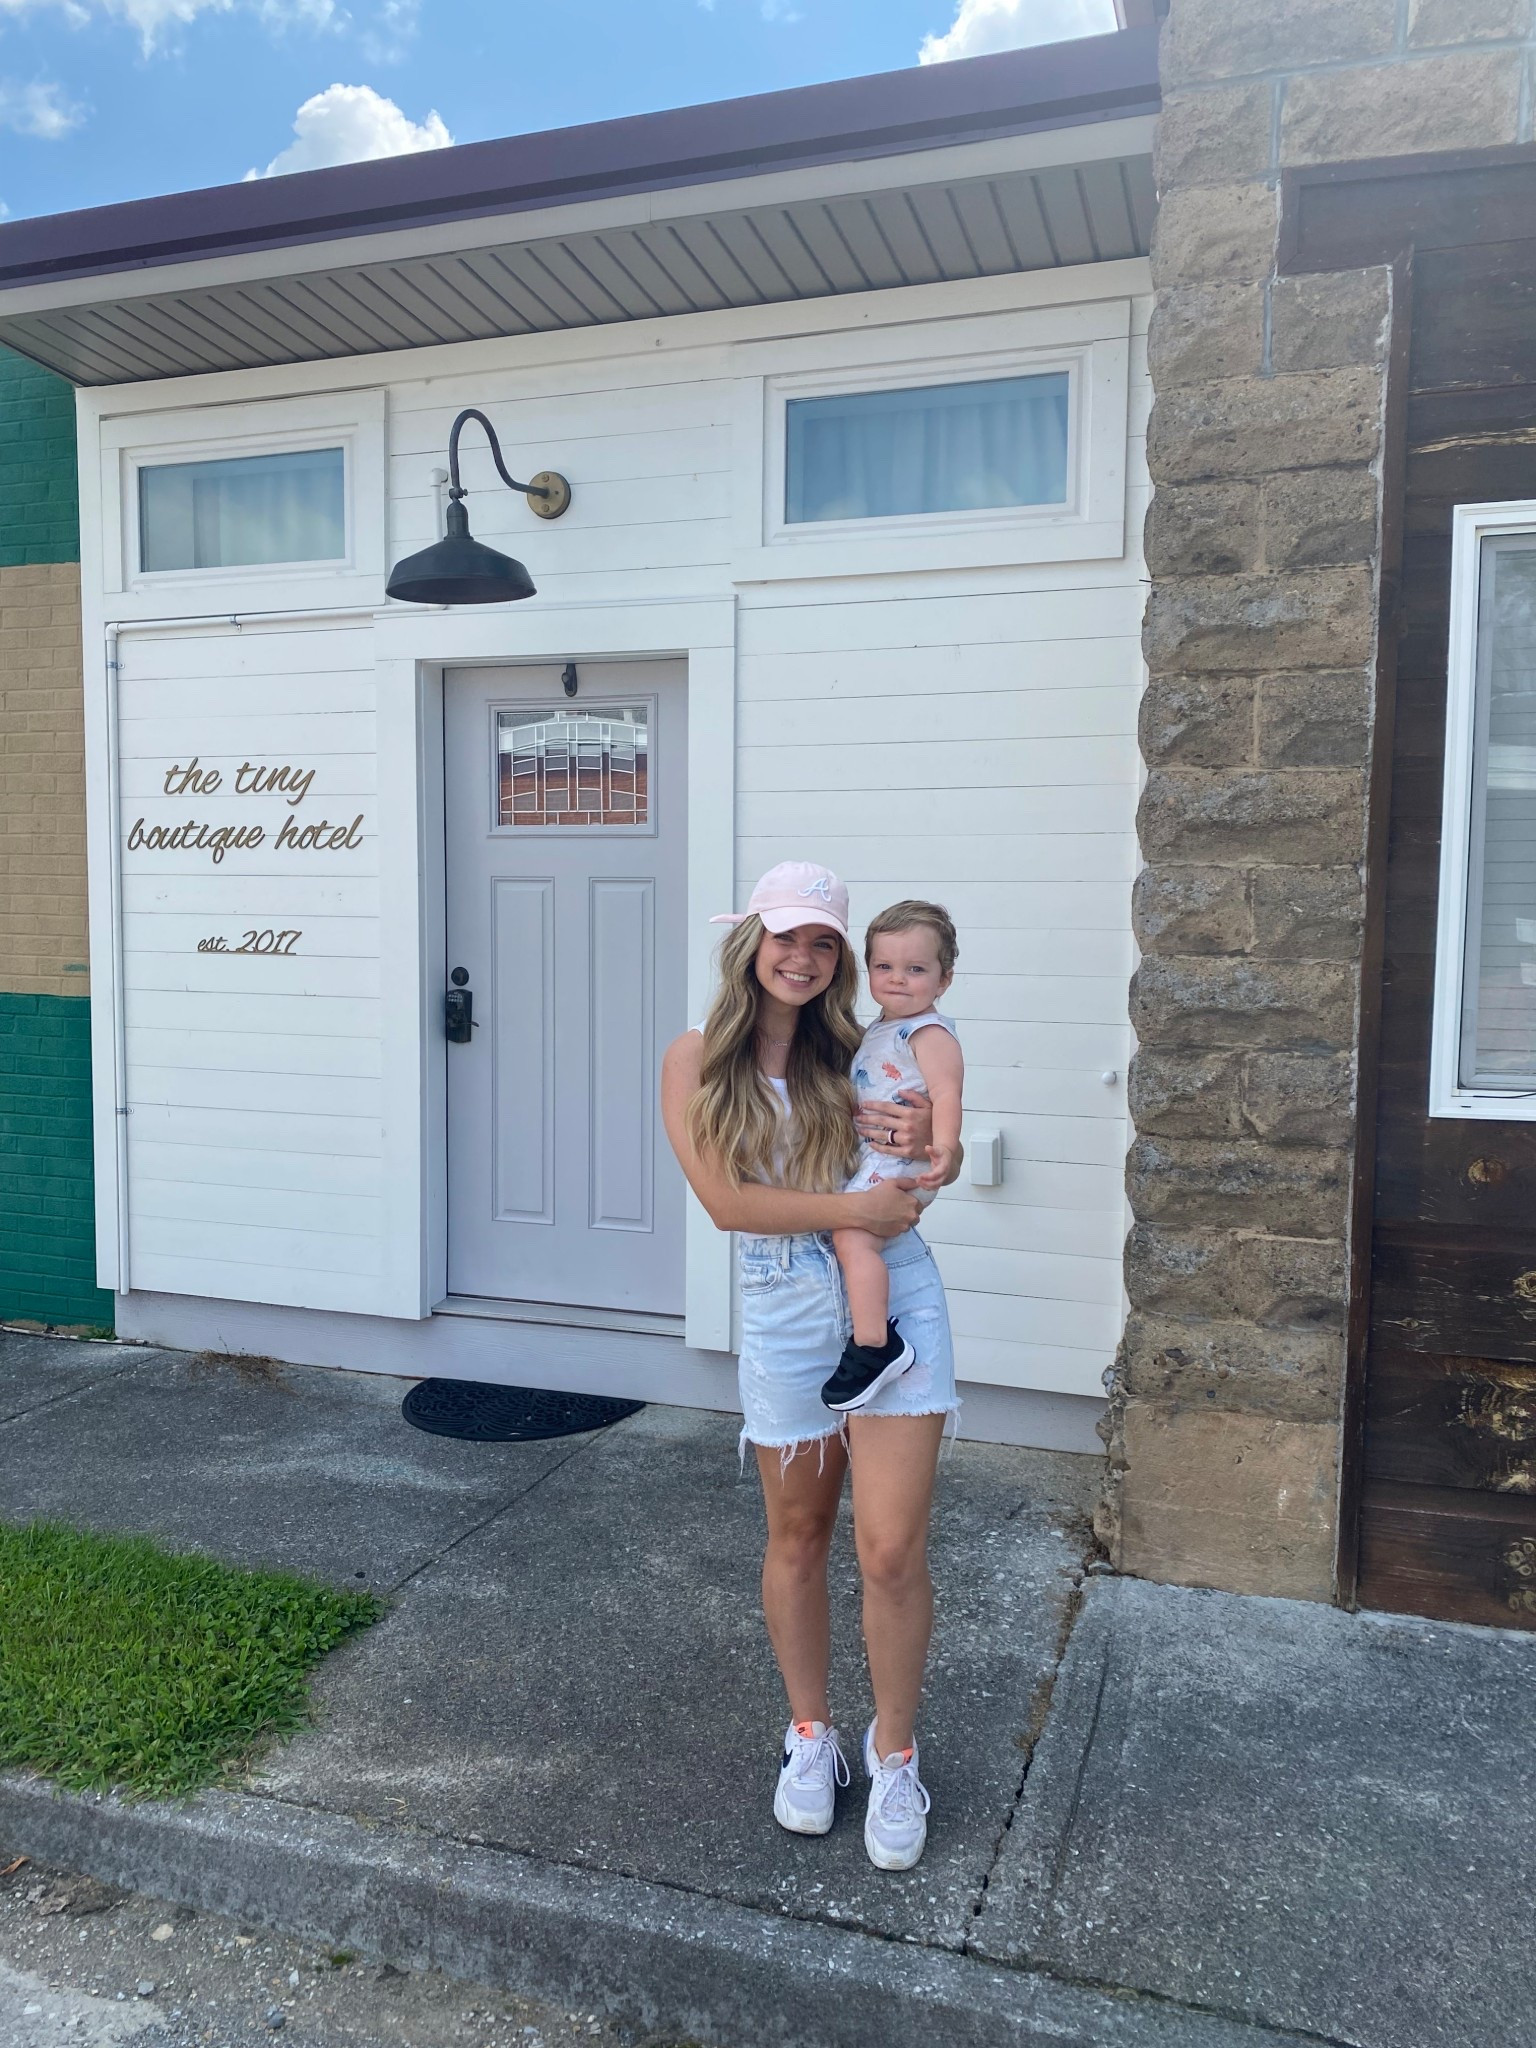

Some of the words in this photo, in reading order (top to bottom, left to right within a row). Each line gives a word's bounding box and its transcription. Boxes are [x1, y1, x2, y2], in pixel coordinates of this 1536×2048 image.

[163, 757, 222, 794] the
[235, 762, 315, 805] tiny
[127, 818, 265, 864] boutique
[274, 814, 364, 850] hotel
[797, 877, 832, 902] A
[197, 936, 229, 952] est.
[236, 929, 302, 954] 2017
